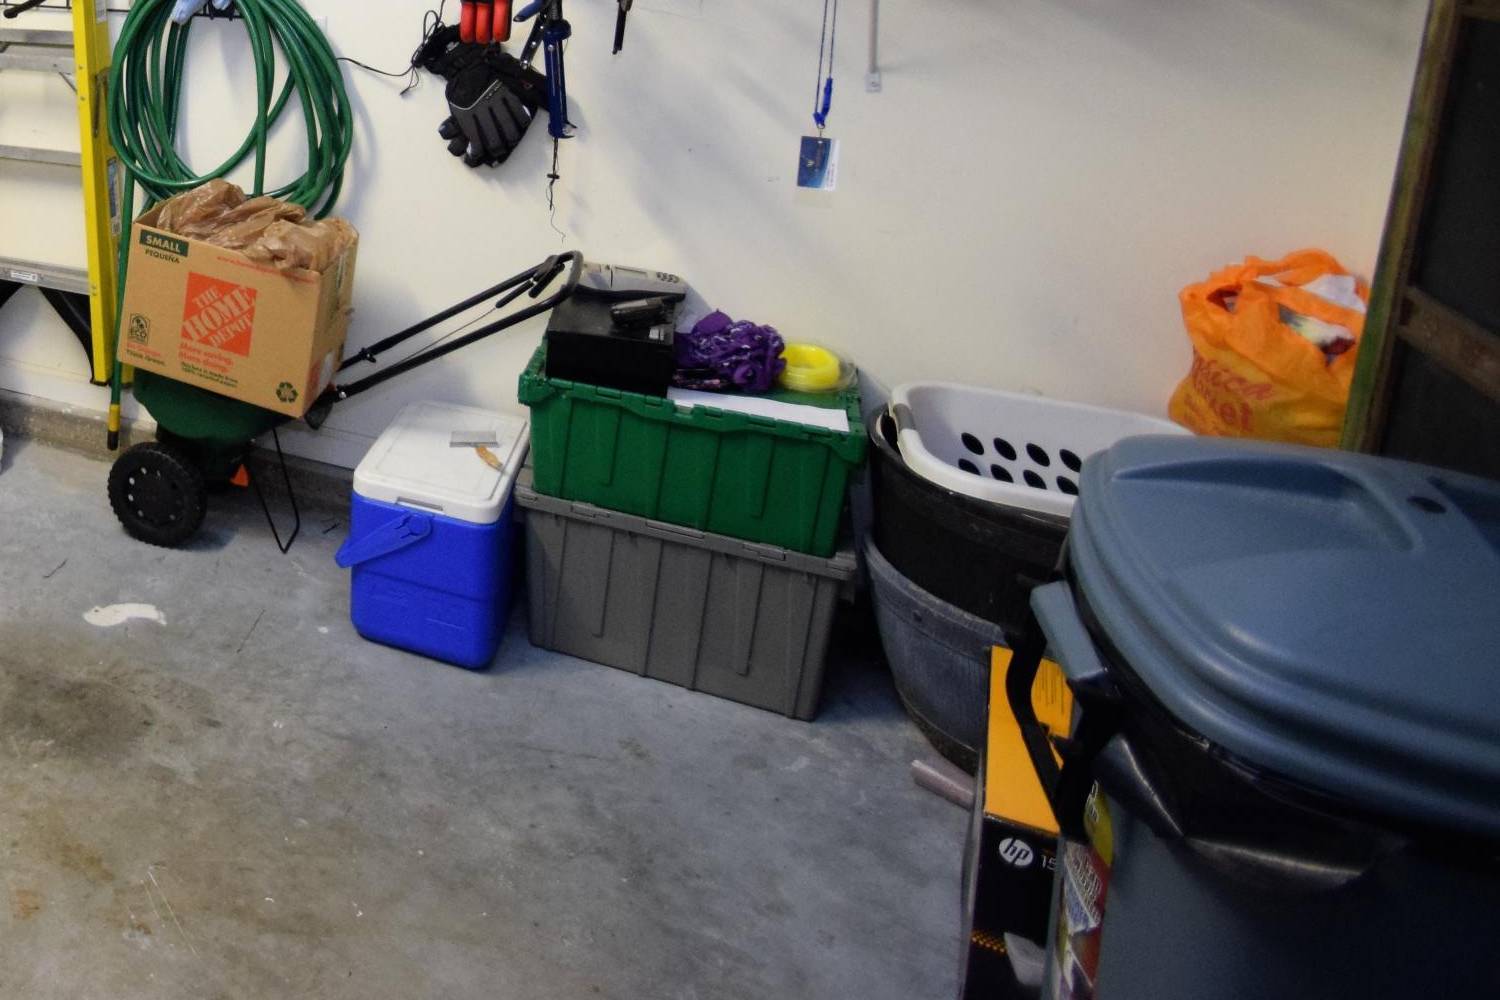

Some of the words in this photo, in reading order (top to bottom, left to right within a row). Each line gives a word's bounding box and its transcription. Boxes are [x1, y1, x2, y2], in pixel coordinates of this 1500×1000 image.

[145, 248, 181, 264] PEQUEÑA
[146, 235, 181, 253] SMALL
[193, 286, 220, 307] THE
[182, 287, 256, 341] HOME
[209, 315, 252, 347] DEPOT
[1002, 837, 1030, 867] hp
